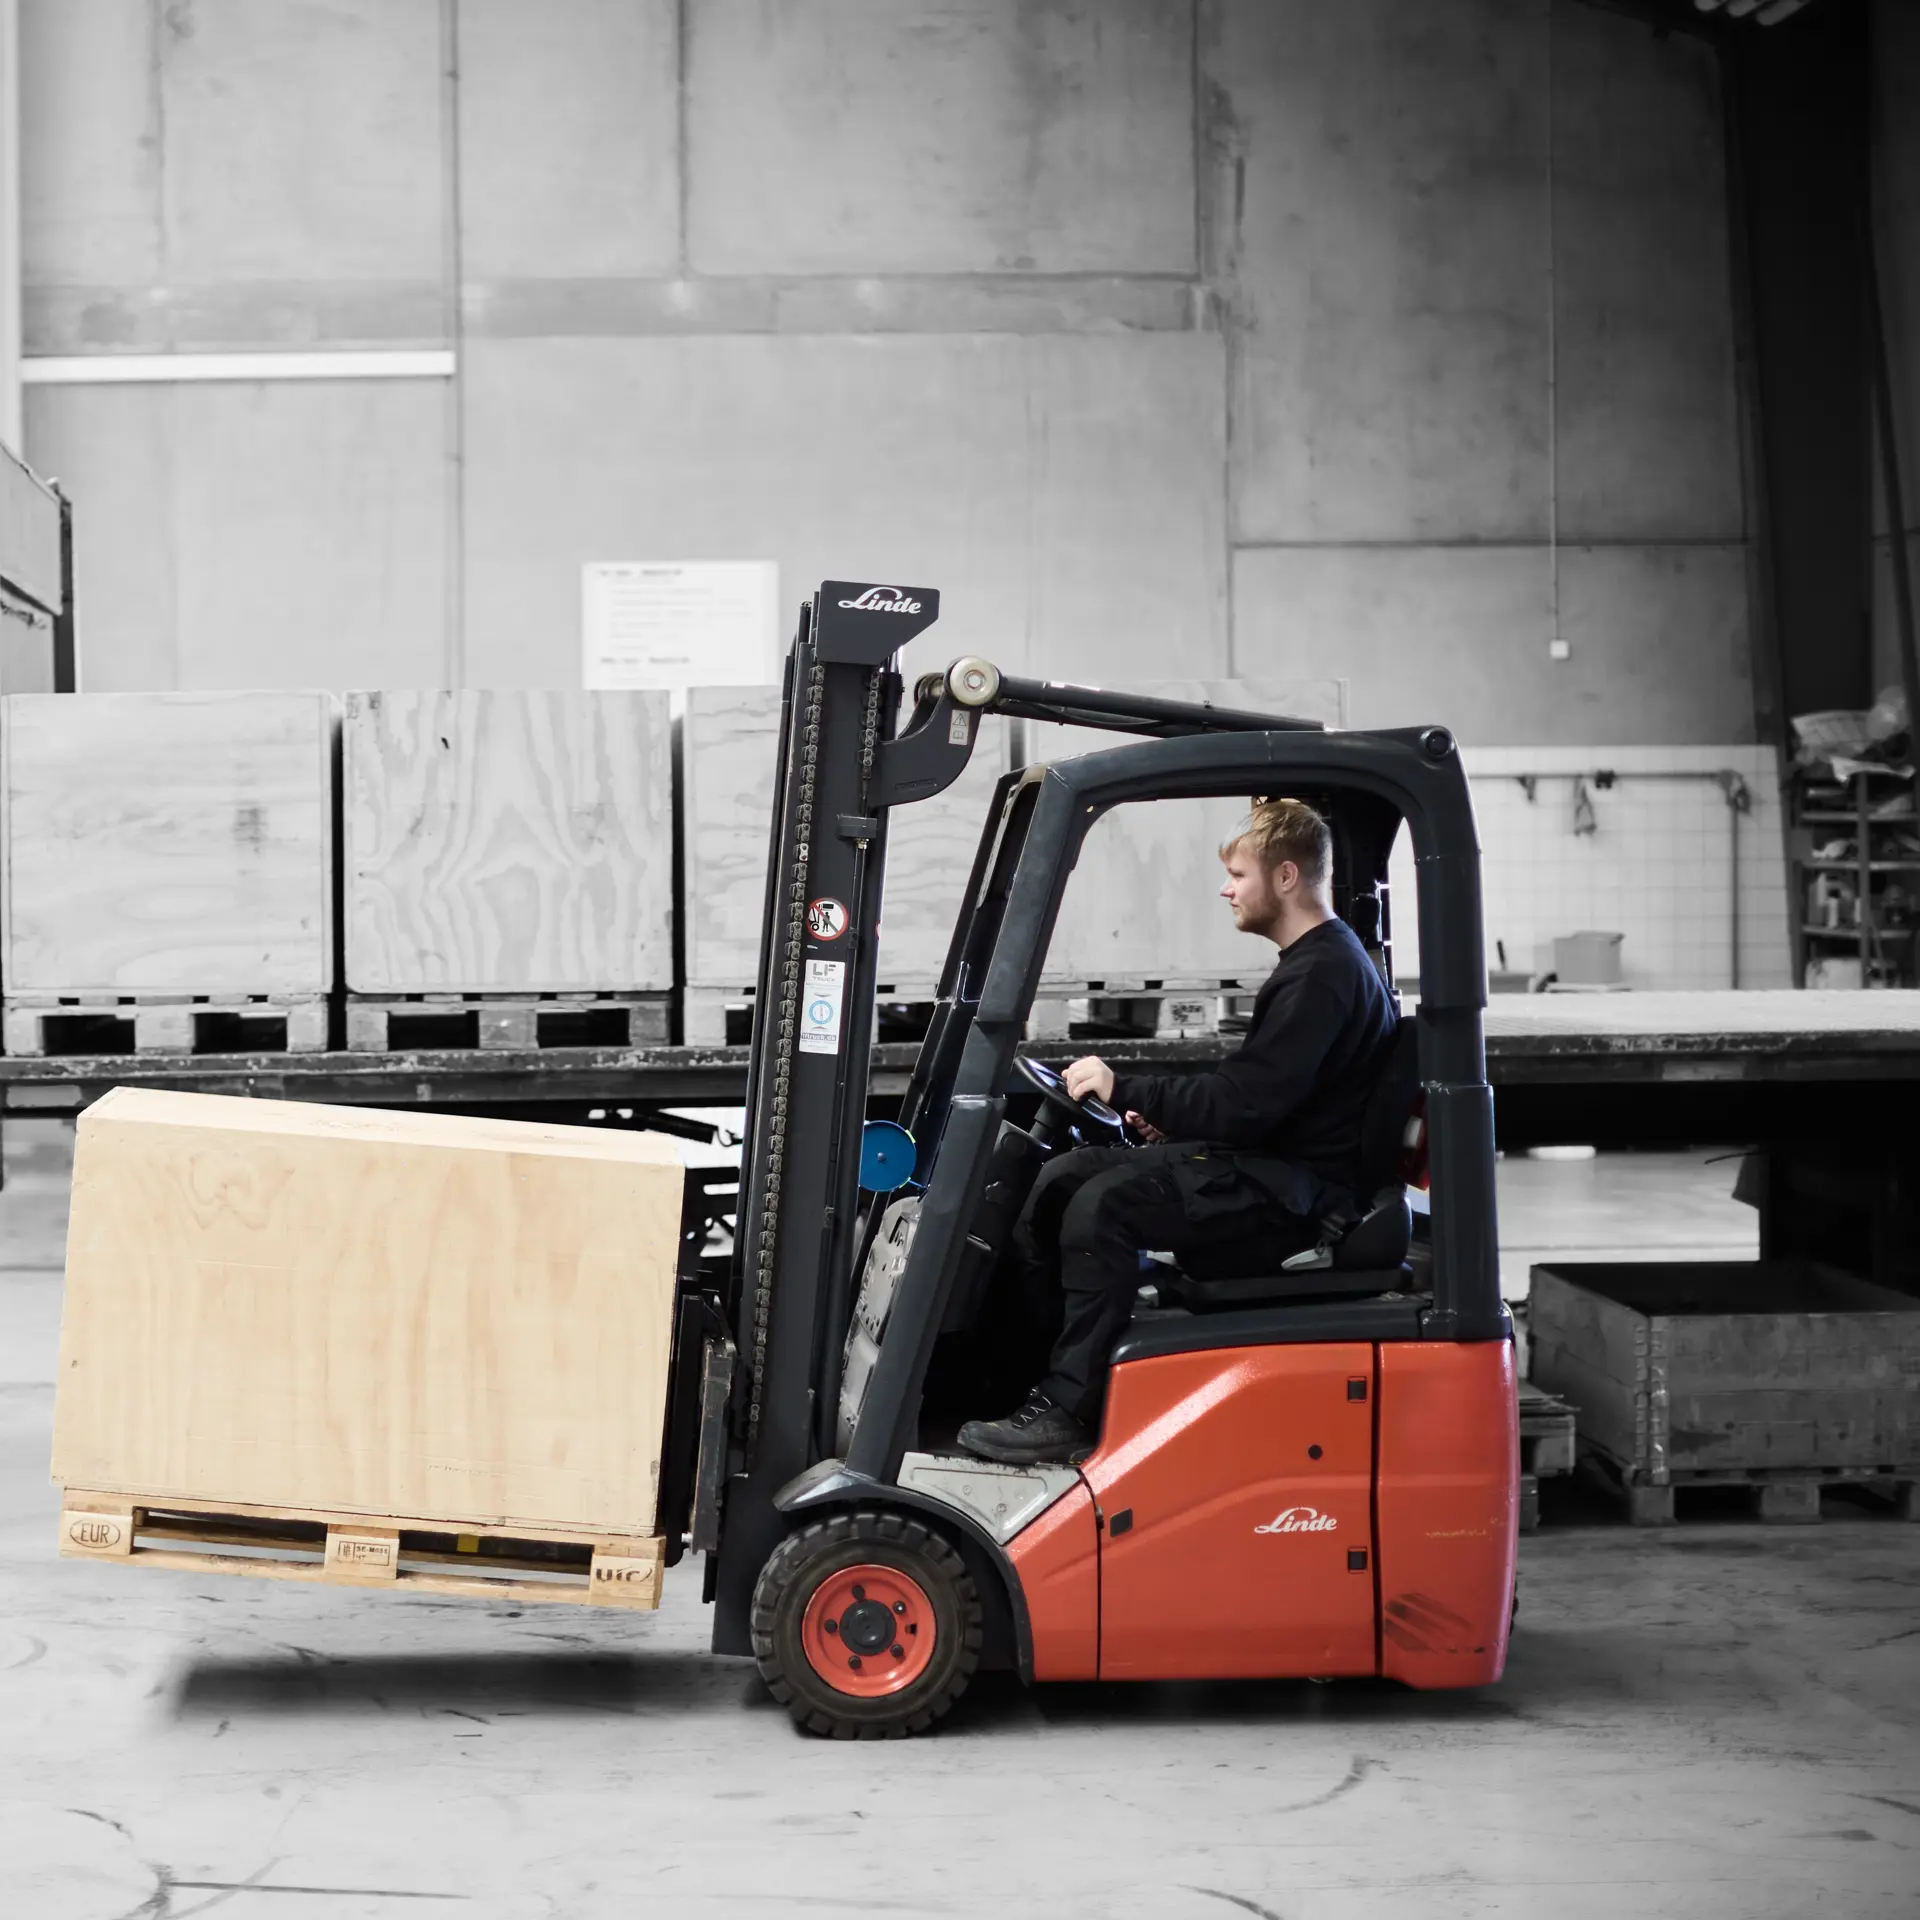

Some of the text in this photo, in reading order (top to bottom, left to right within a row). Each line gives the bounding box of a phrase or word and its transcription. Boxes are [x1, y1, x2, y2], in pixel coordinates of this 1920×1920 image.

[838, 586, 922, 614] Linde
[80, 1523, 110, 1544] EUR
[1254, 1506, 1338, 1534] Linde
